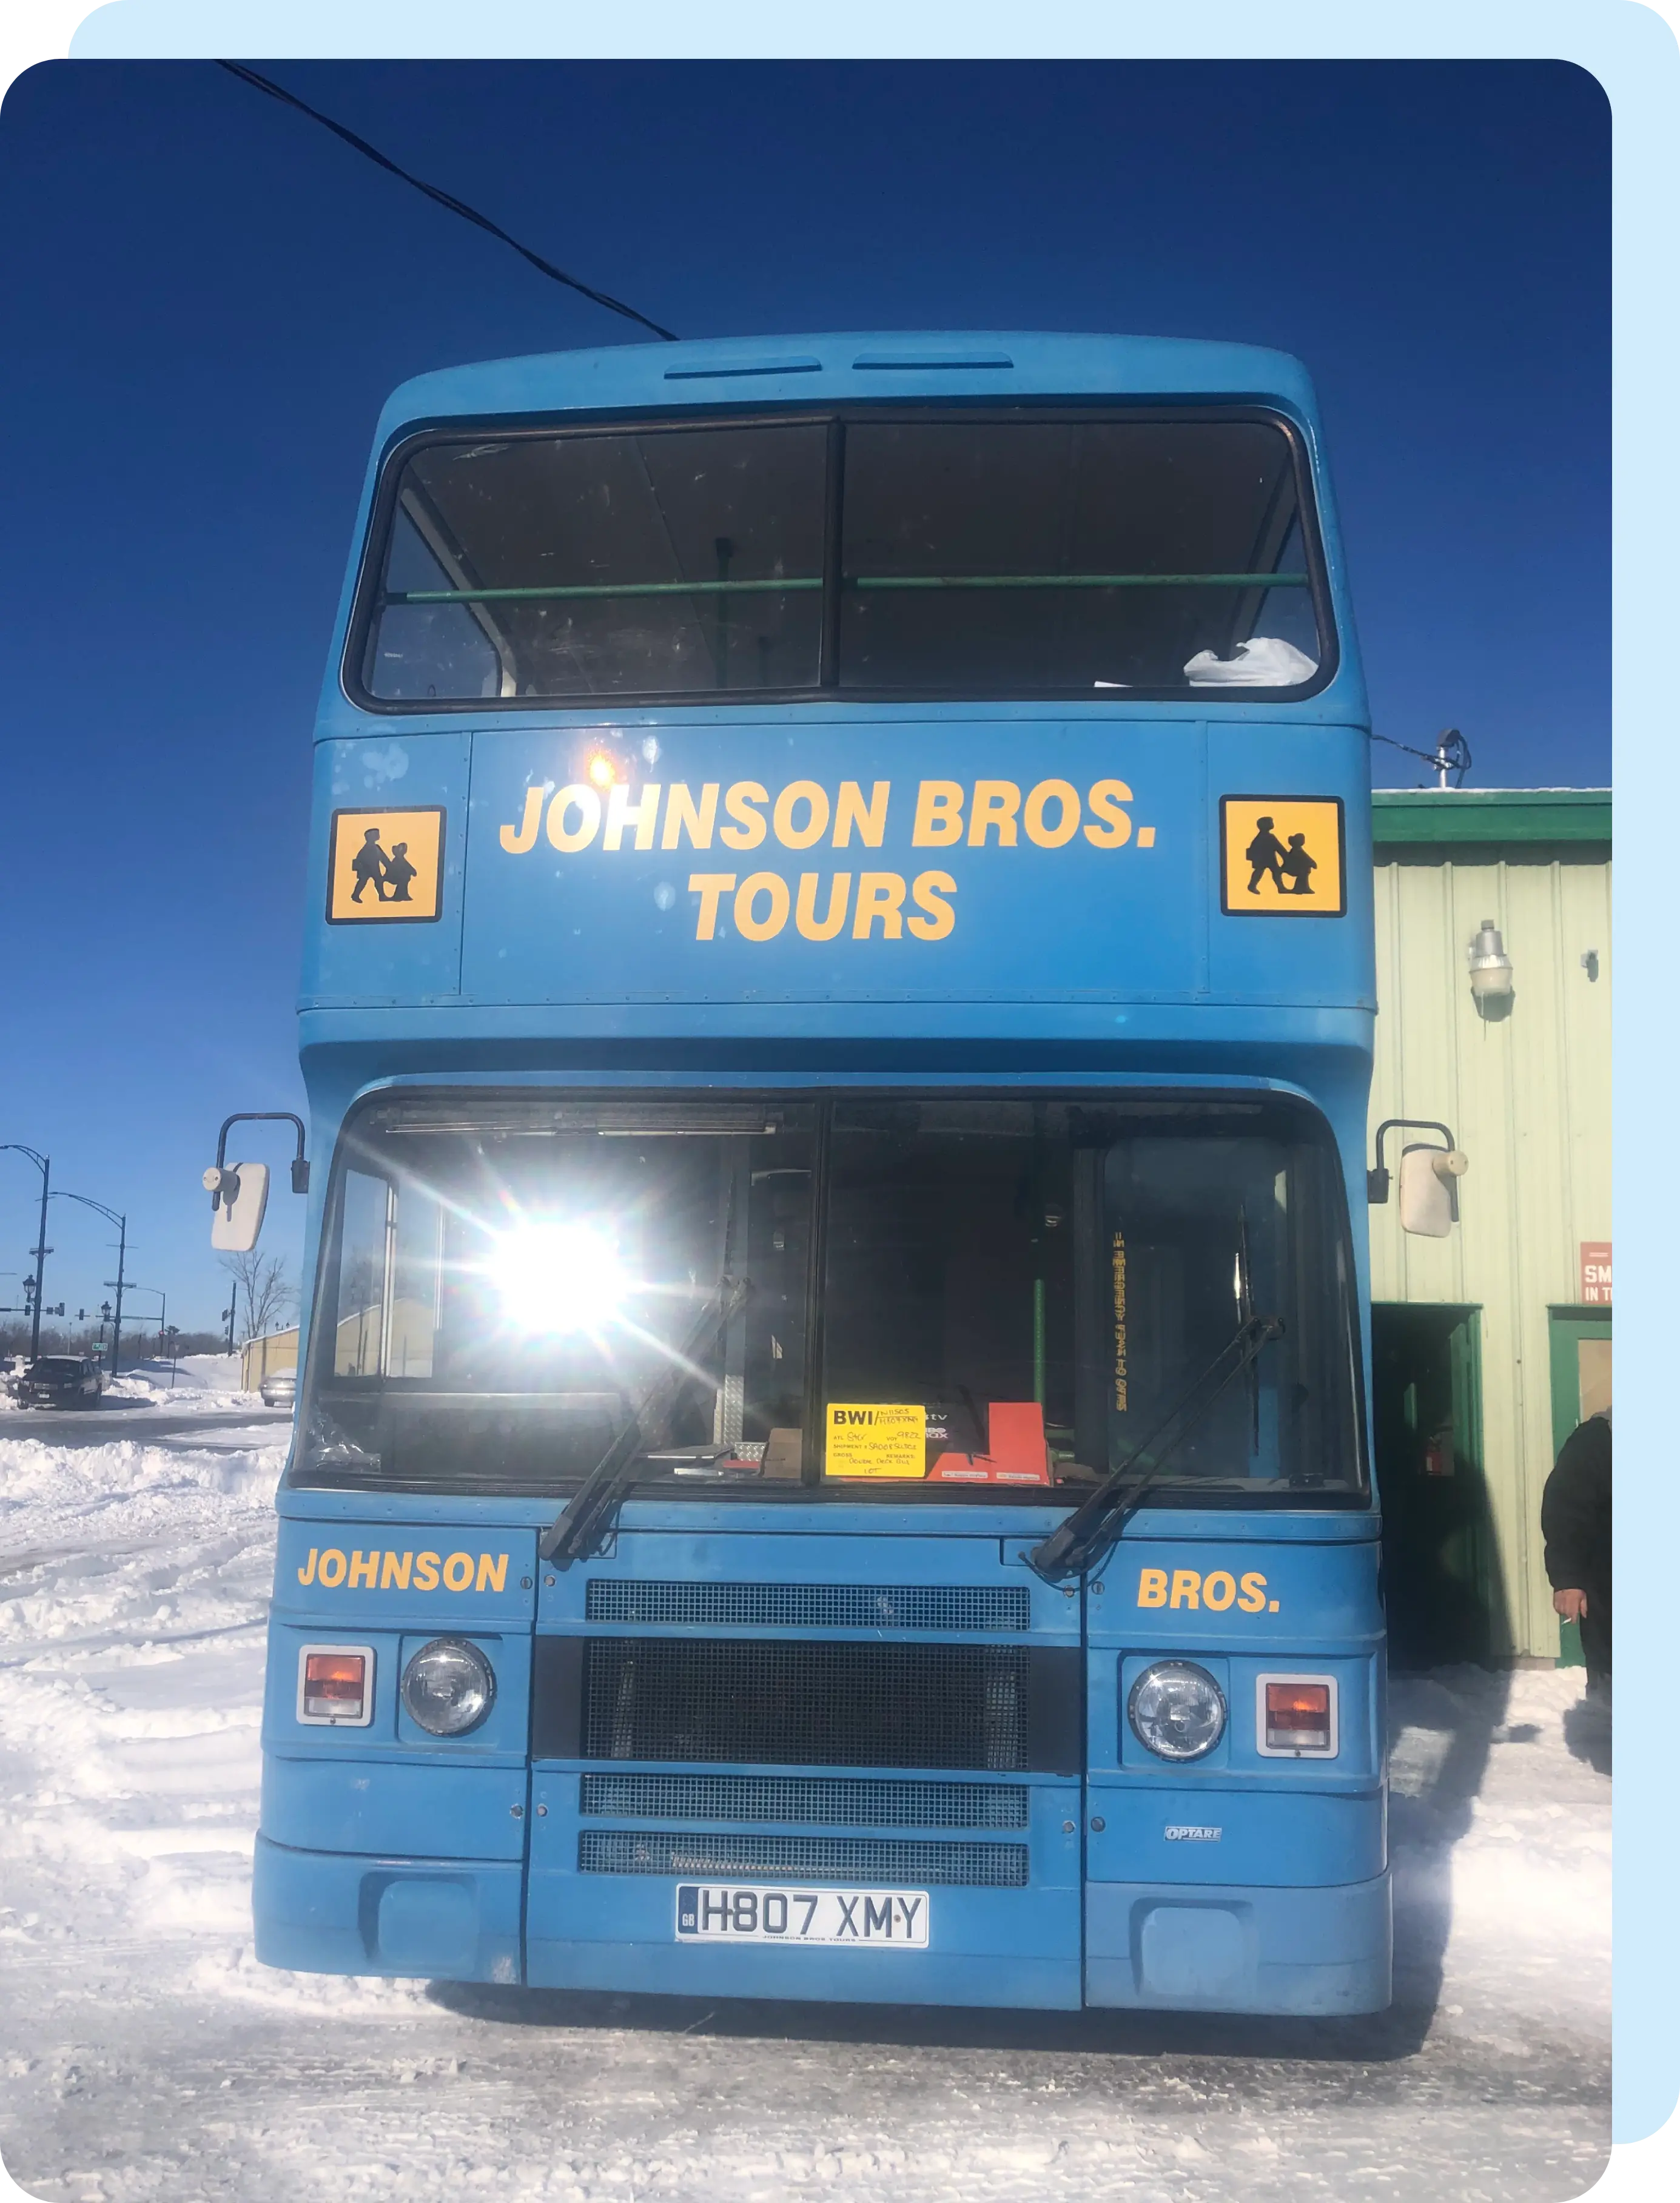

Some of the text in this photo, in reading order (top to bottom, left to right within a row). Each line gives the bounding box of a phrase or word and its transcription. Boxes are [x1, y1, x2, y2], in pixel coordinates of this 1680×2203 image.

[500, 779, 1155, 853] JOHNSON BROS.
[688, 871, 956, 941] TOURS
[1585, 1286, 1599, 1301] IN
[298, 1549, 509, 1592] JOHNSON
[1137, 1569, 1280, 1613] BROS.
[1166, 1828, 1221, 1840] OPTARE
[682, 1913, 695, 1927] GB
[702, 1890, 922, 1939] H807 XMY
